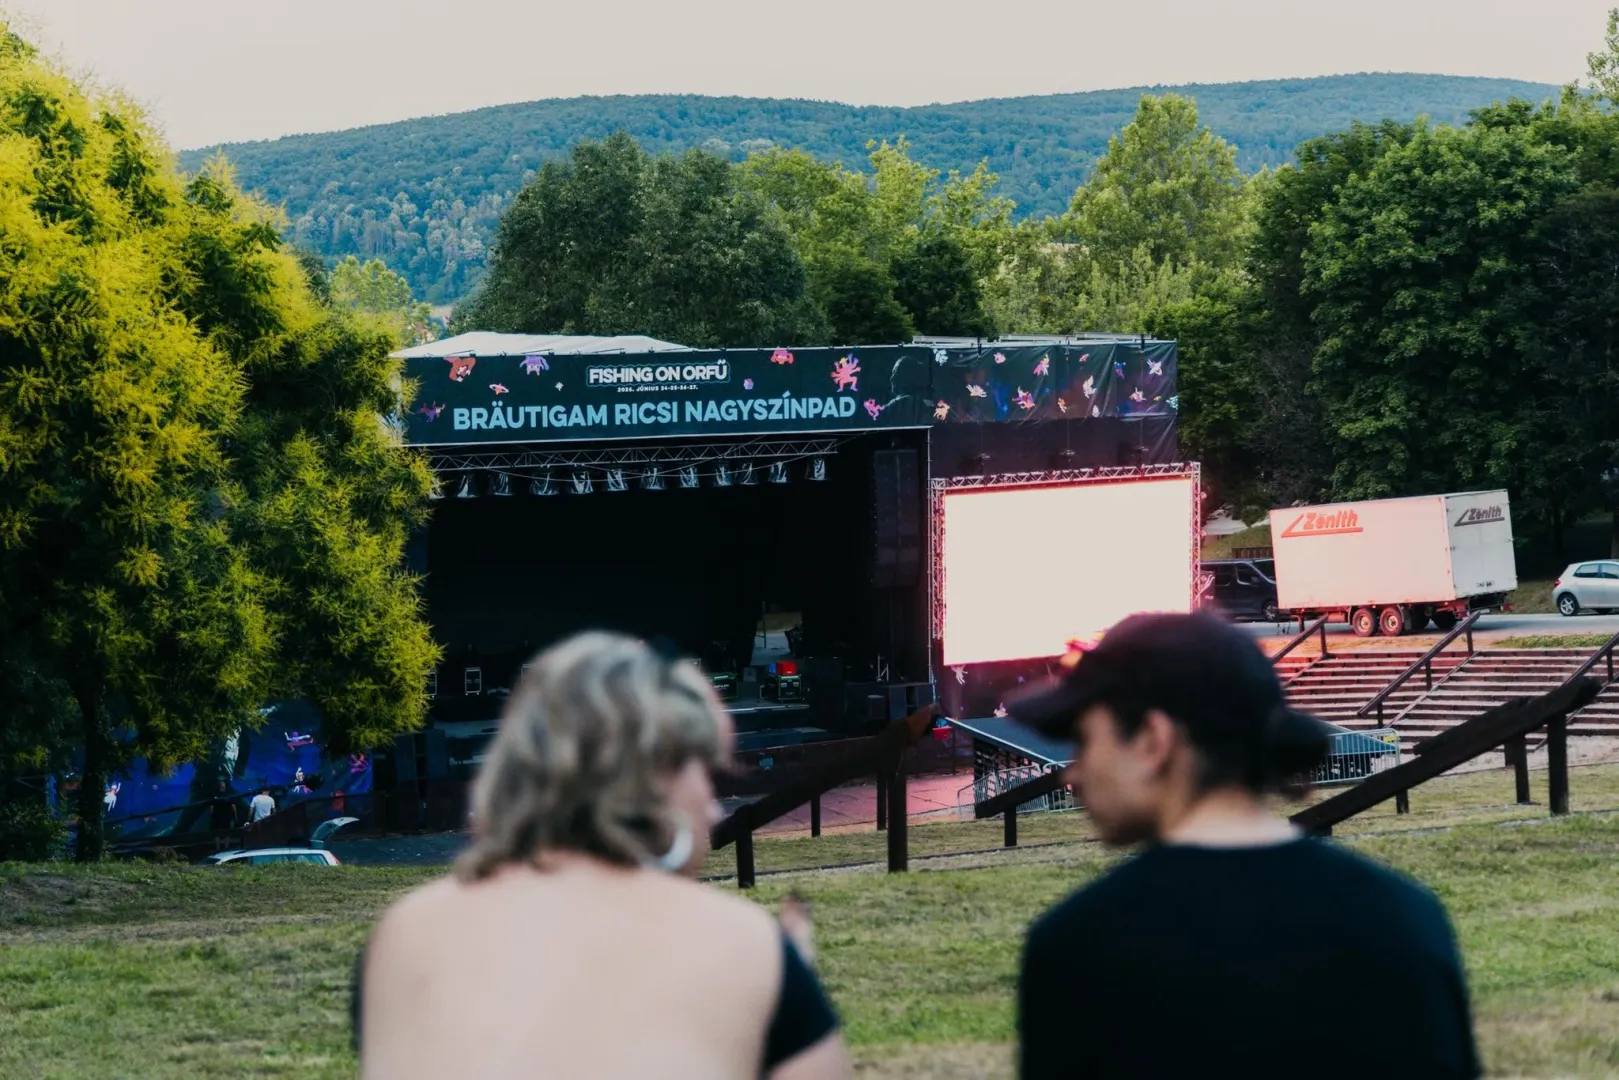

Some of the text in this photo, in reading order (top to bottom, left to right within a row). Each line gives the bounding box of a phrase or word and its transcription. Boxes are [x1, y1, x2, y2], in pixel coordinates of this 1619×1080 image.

[589, 367, 653, 384] FISHING
[655, 366, 681, 381] ON
[453, 391, 856, 430] BRÄUTIGAM RICSI NAGYSZÍNPAD
